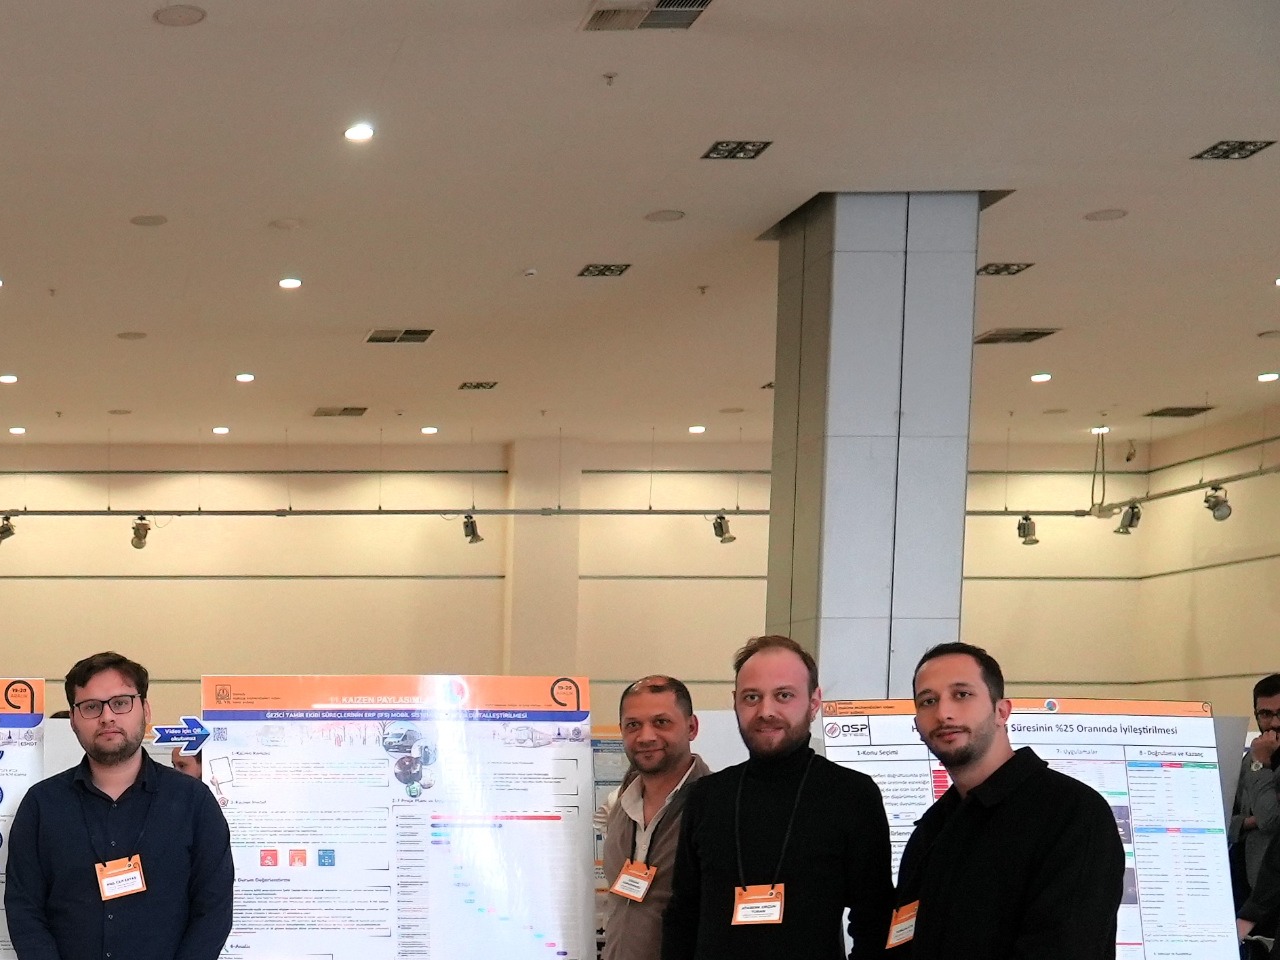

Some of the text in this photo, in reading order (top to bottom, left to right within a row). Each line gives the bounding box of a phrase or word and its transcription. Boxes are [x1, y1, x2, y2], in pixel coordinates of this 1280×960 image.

[841, 723, 868, 733] OSP
[1011, 723, 1178, 735] Süresinin %25 Oranında İyileştirilmesi
